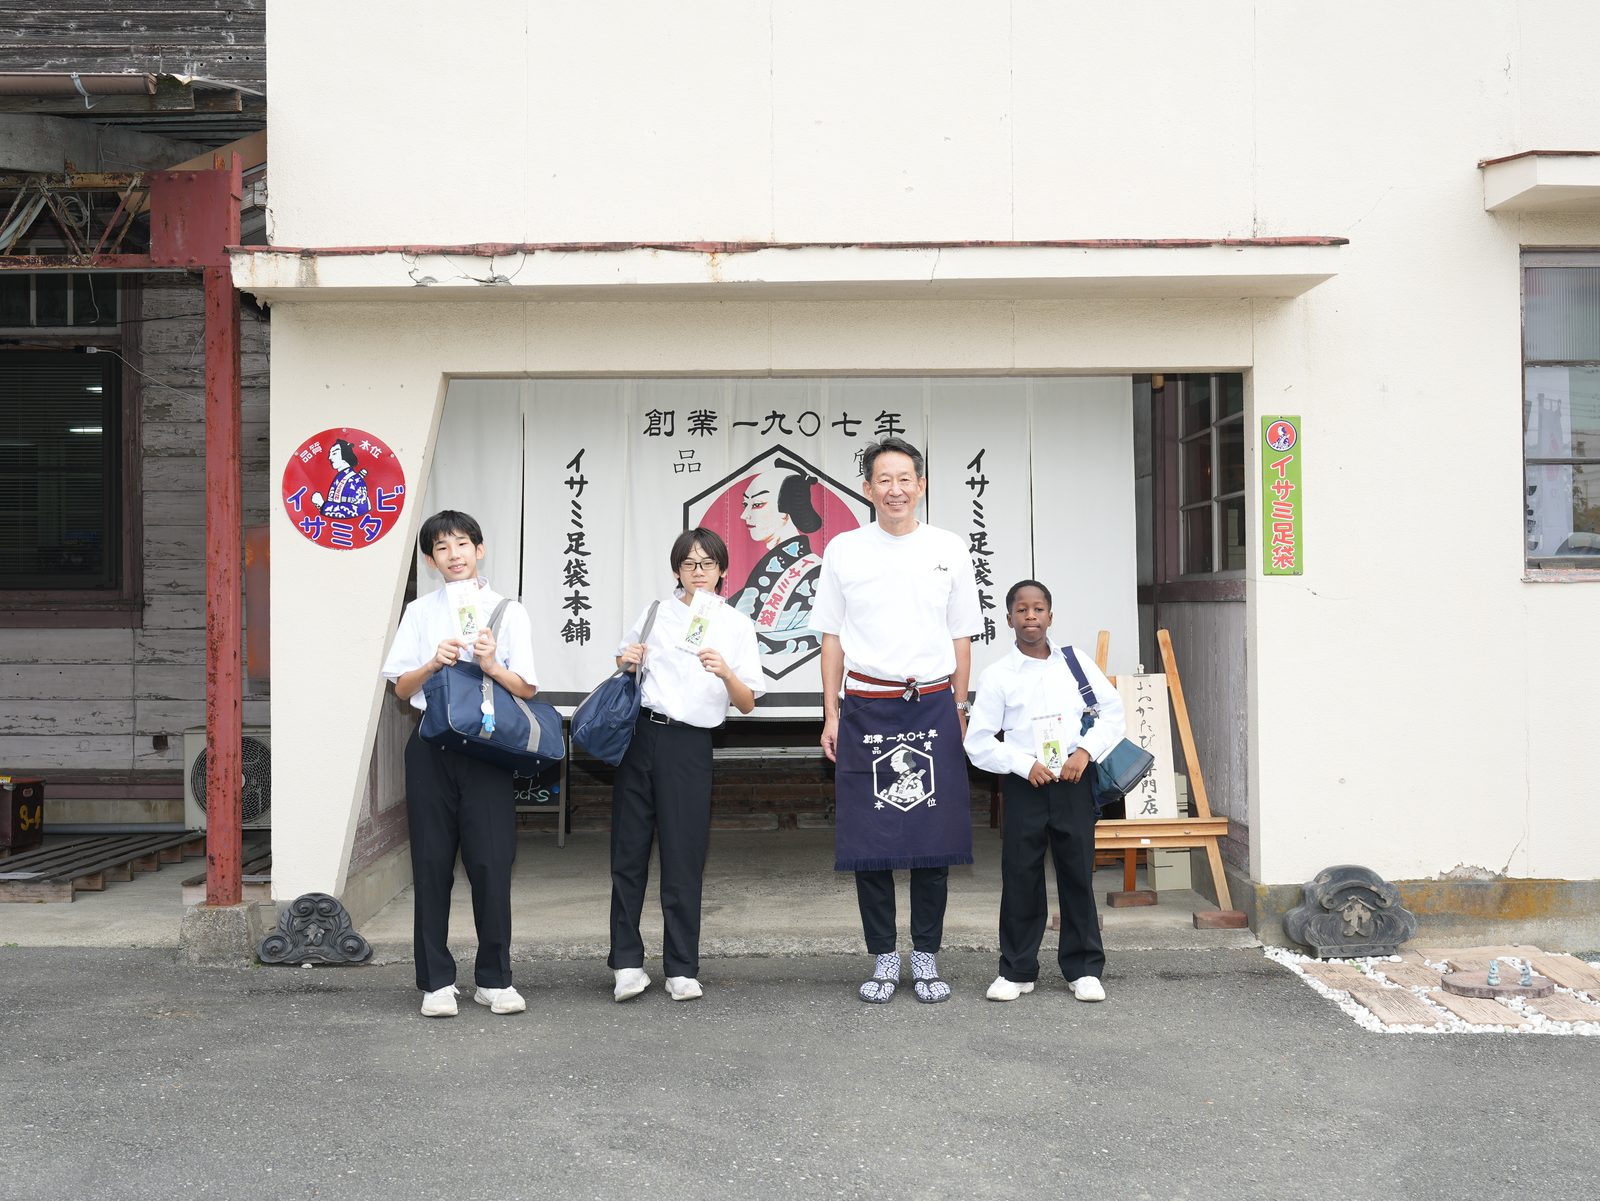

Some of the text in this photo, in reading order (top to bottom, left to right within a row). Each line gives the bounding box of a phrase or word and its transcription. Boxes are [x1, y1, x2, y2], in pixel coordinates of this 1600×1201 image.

[673, 449, 702, 474] 品
[1270, 455, 1295, 569] イサミ足袋
